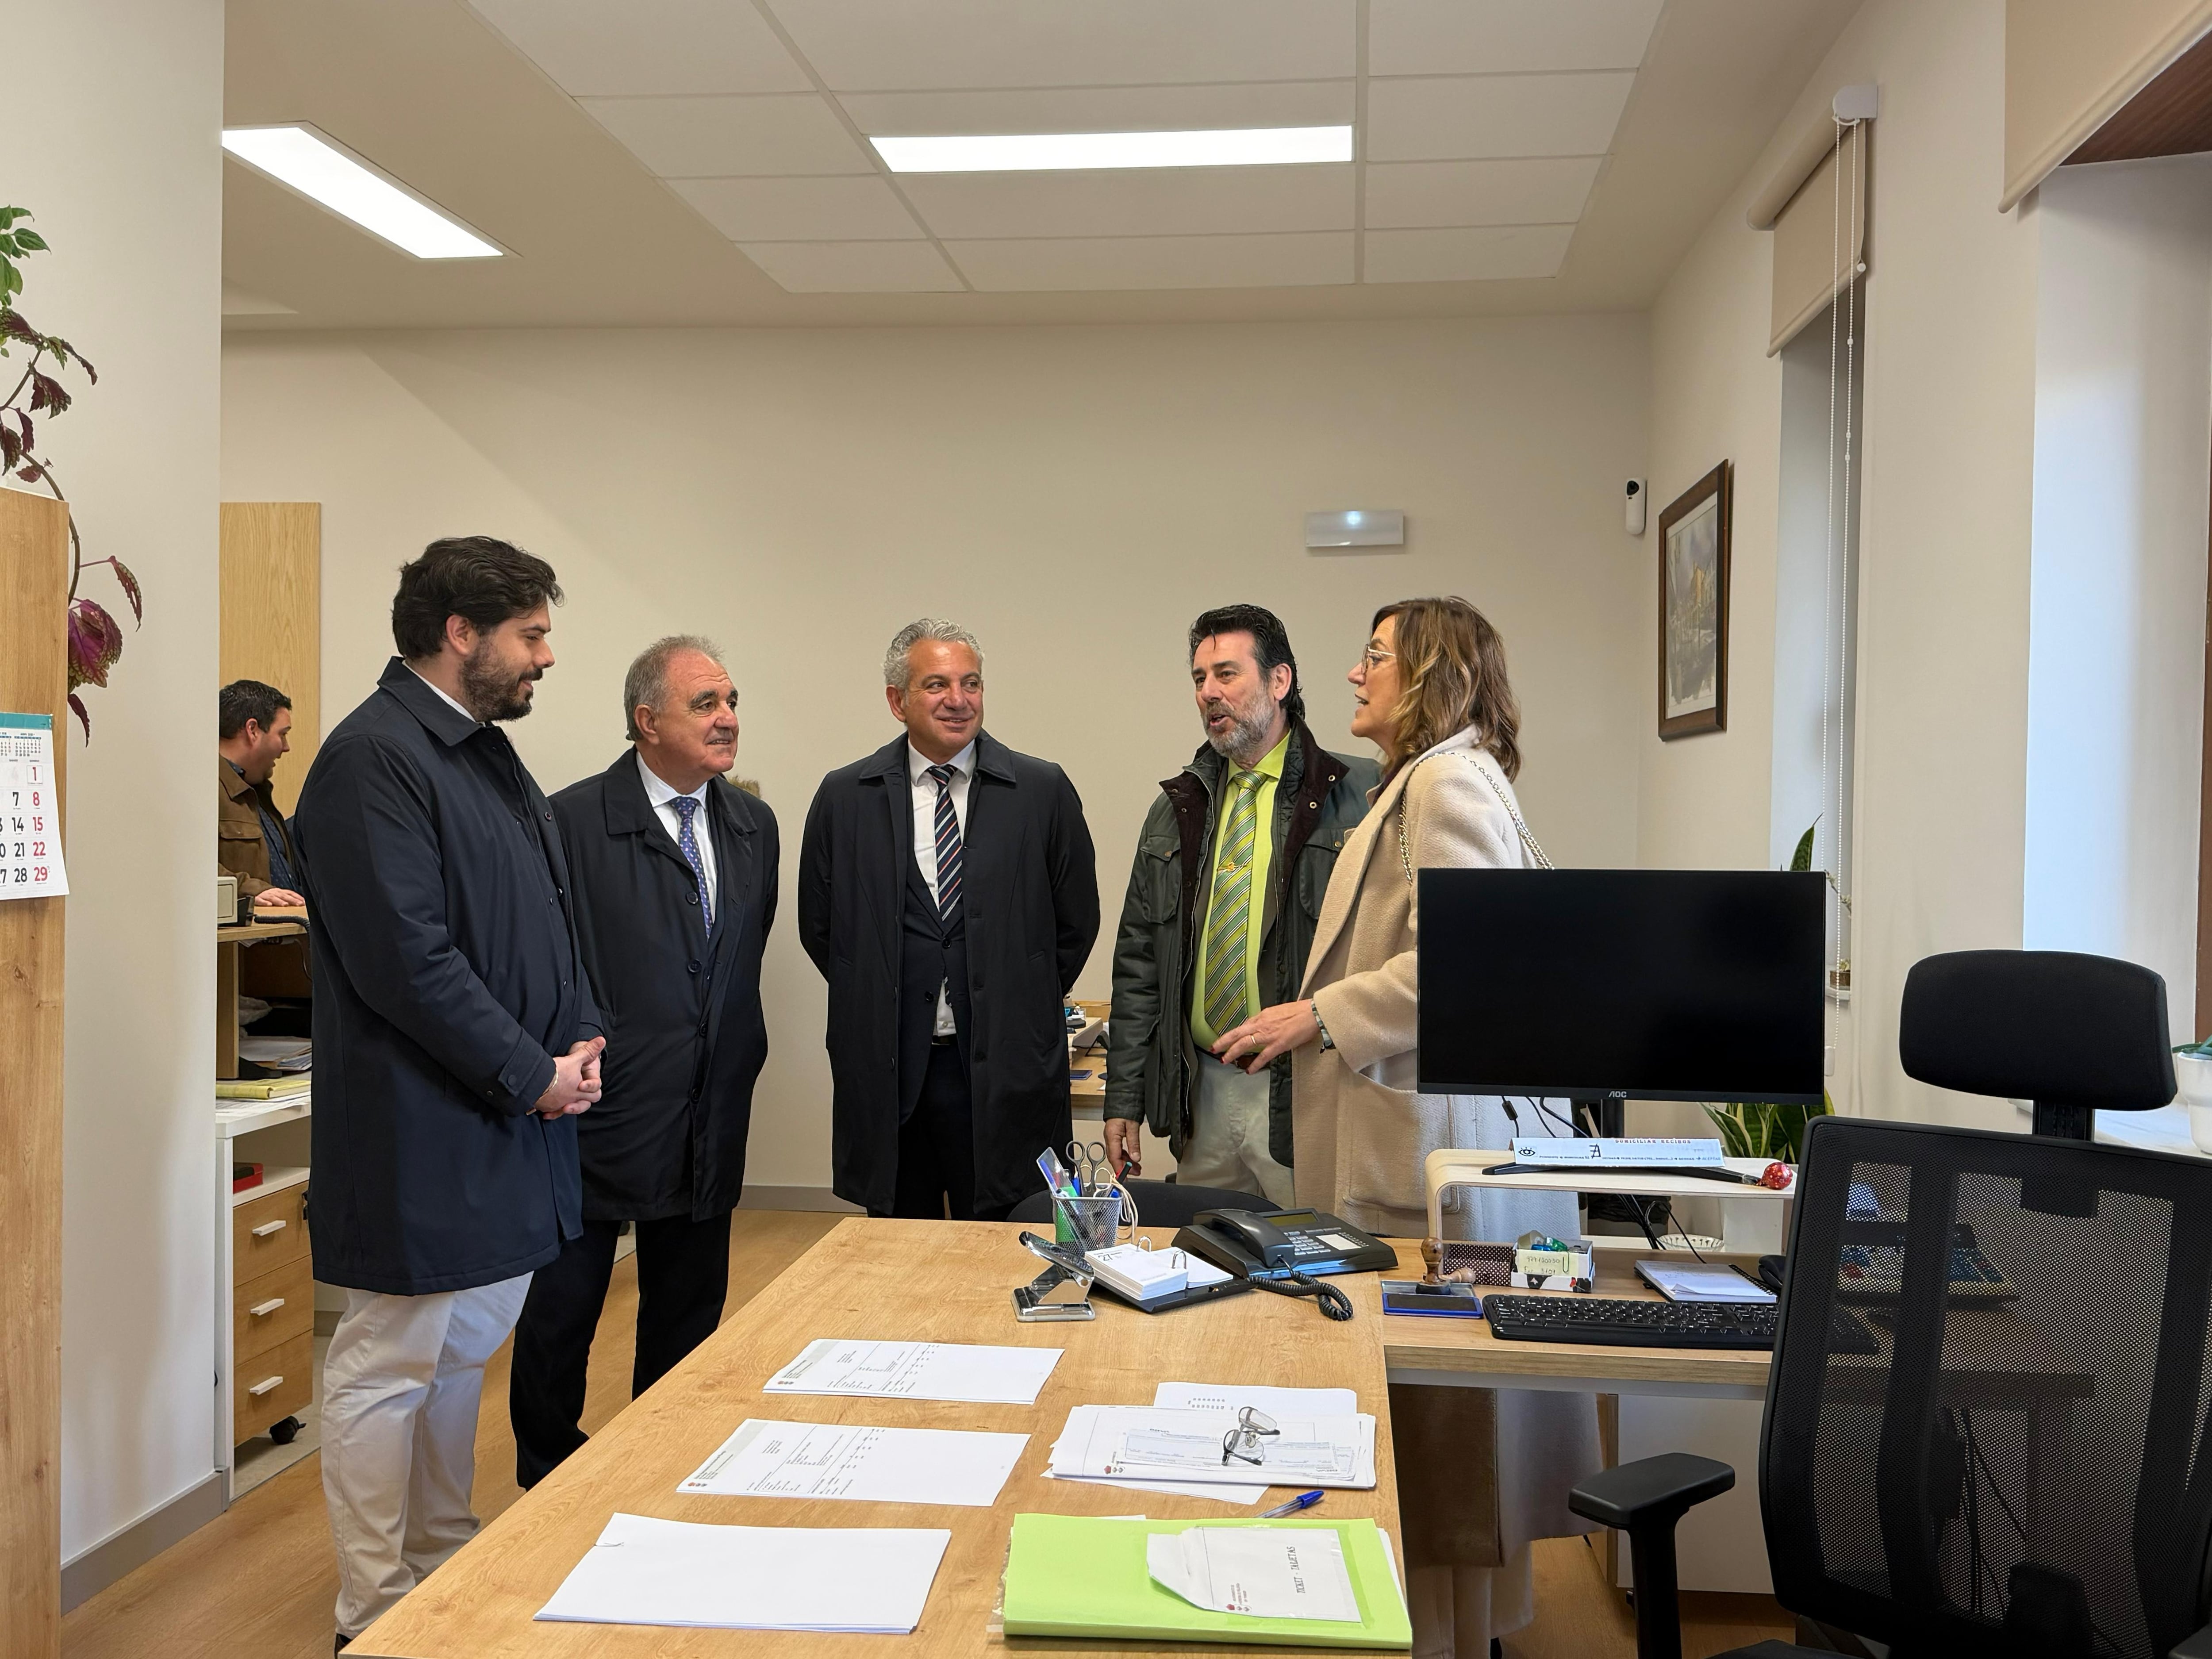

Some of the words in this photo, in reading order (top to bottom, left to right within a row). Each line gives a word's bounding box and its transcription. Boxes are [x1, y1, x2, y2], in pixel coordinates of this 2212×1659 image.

[32, 766, 36, 781] 1
[12, 791, 19, 806] 7
[33, 791, 40, 806] 8
[12, 817, 24, 832] 14
[32, 817, 43, 831] 15
[0, 843, 6, 858] 0
[14, 842, 25, 857] 21
[33, 841, 46, 856] 22
[0, 868, 7, 883] 7
[14, 867, 27, 883] 28
[34, 866, 48, 882] 29
